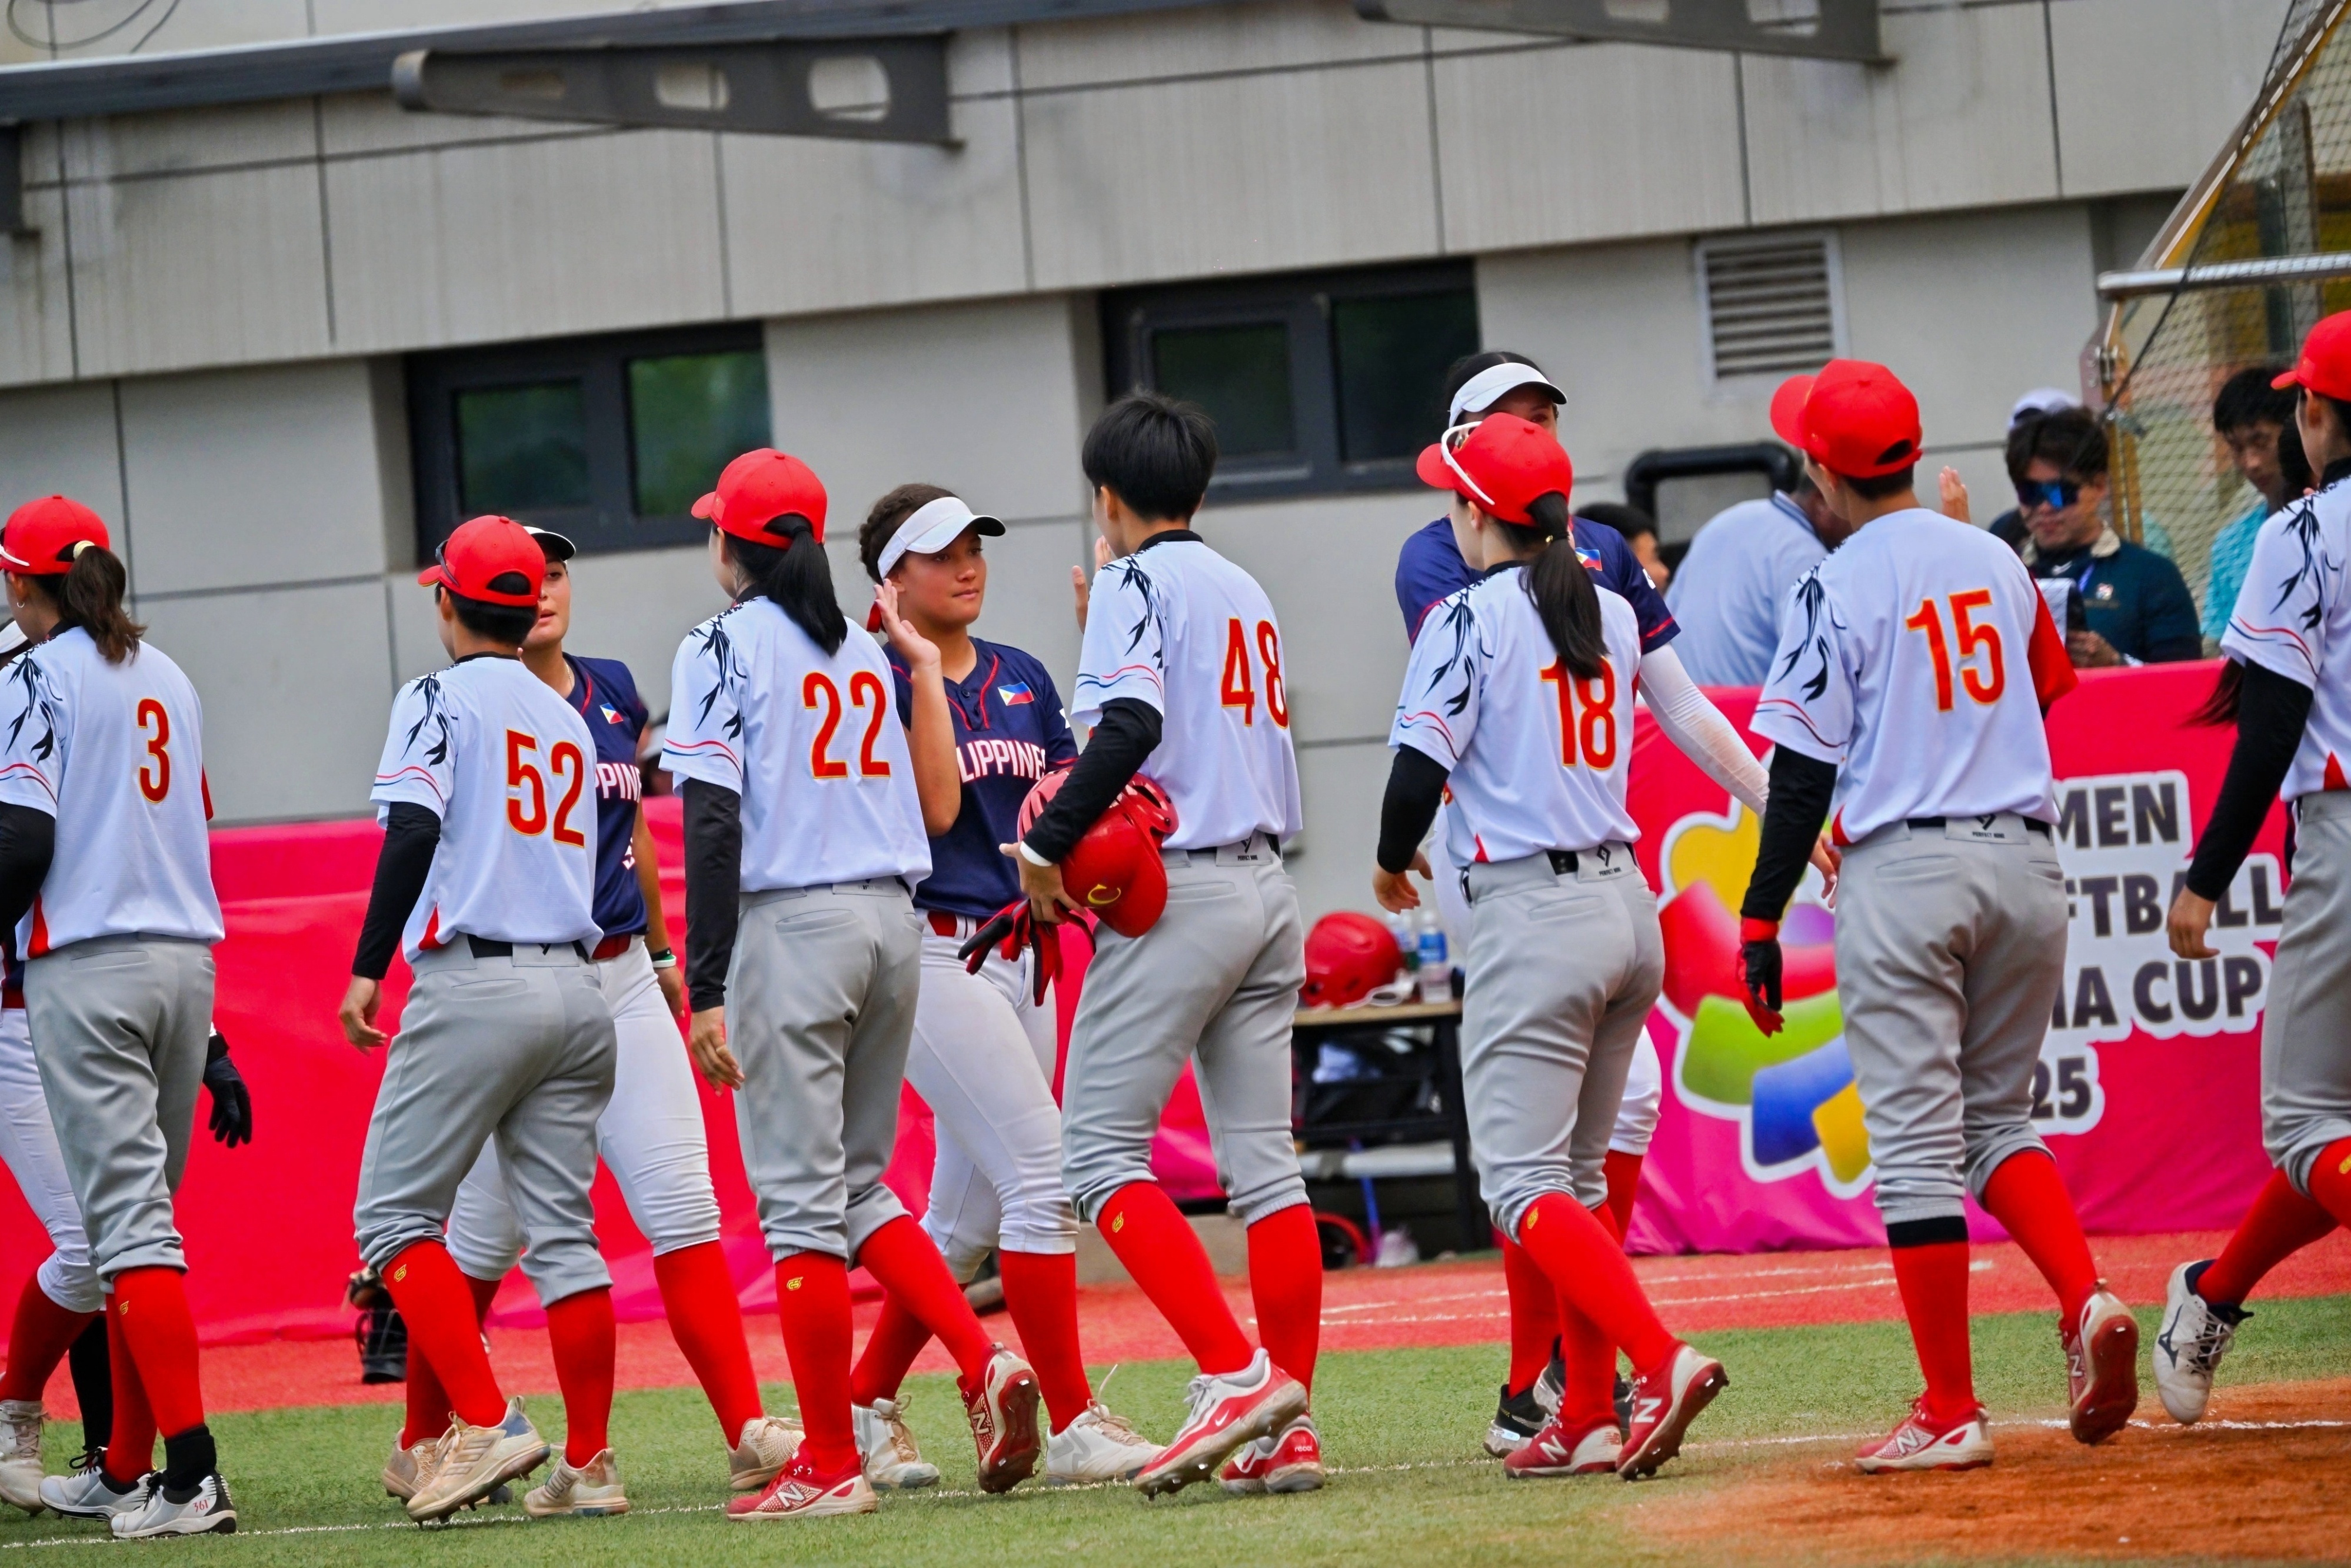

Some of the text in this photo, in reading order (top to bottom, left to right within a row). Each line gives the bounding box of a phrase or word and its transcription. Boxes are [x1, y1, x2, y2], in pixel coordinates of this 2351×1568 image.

[1221, 617, 1288, 729] 48
[1906, 589, 2004, 713] 15
[137, 698, 170, 803] 3
[802, 671, 891, 779] 22
[1540, 655, 1617, 770] 18
[506, 728, 584, 848] 52
[2133, 956, 2262, 1024] CUP
